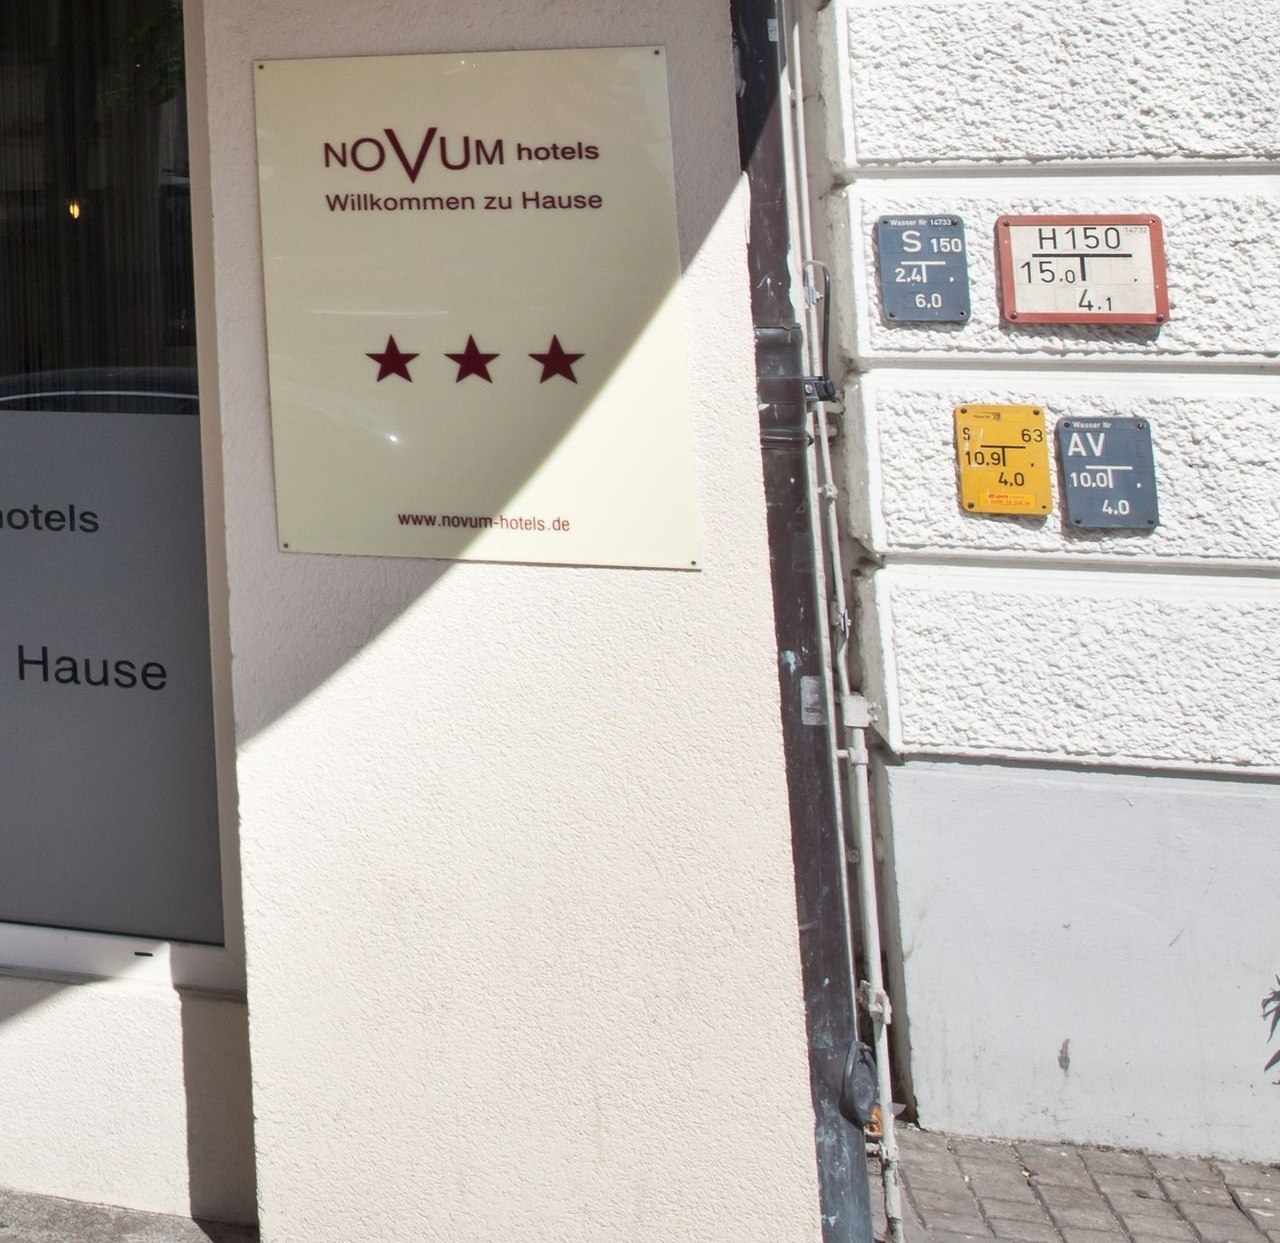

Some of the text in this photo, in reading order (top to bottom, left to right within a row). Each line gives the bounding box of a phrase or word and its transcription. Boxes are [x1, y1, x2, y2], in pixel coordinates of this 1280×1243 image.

[323, 127, 600, 184] NOVUM hotels
[325, 192, 604, 213] Willkommen zu Hause
[902, 230, 962, 253] S 150
[1020, 261, 1076, 284] 15.0
[1078, 289, 1112, 311] 4.1
[962, 427, 1043, 442] S 63
[1067, 432, 1105, 456] AV
[397, 512, 571, 532] www.novum-hotels.de
[17, 645, 169, 692] Hause
